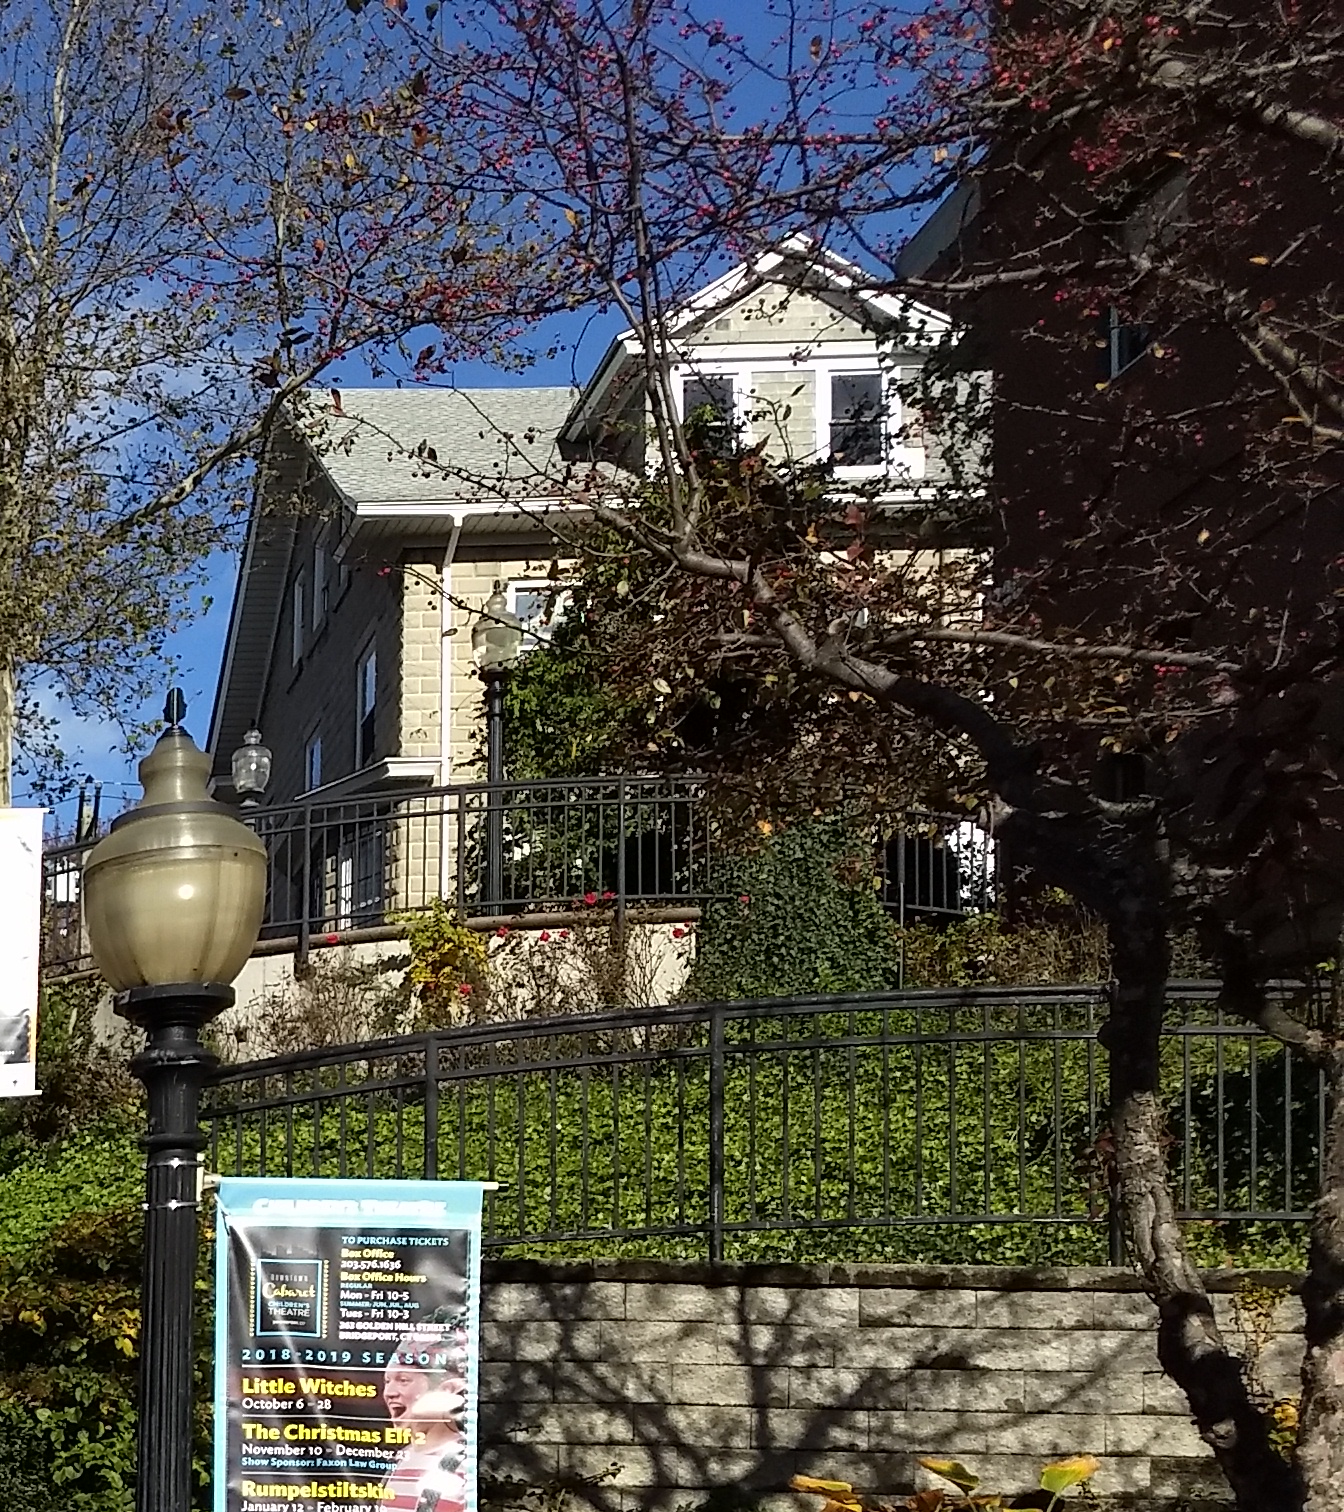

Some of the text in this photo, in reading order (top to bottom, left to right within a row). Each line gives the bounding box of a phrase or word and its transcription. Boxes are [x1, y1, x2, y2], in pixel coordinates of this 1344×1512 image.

[341, 1236, 450, 1247] TO PURCHASE TICKETS
[340, 1248, 395, 1259] Box Office
[340, 1260, 402, 1270] 203.576.1636
[340, 1271, 428, 1283] Box Office Hours
[262, 1282, 316, 1299] Cabaret
[340, 1290, 363, 1300] Mon
[371, 1290, 384, 1300] Fri
[387, 1291, 410, 1301] 10-5
[267, 1308, 311, 1318] THEATRE
[340, 1308, 363, 1318] Tues
[371, 1309, 384, 1318] Fri
[387, 1309, 410, 1319] 10-3
[241, 1349, 448, 1366] 2018-2019 SEASON
[241, 1377, 377, 1397] Little Witches
[241, 1398, 293, 1410] October
[296, 1398, 304, 1410] 6
[317, 1399, 332, 1410] 28
[241, 1424, 426, 1444] The Christmas Elf 2
[241, 1444, 306, 1456] November
[309, 1446, 323, 1456] 10
[336, 1445, 395, 1460] December
[241, 1457, 398, 1471] Show Sponsor: Faxon Law Group
[241, 1480, 396, 1500] Rumpelstiltskin
[292, 1503, 304, 1512] 12
